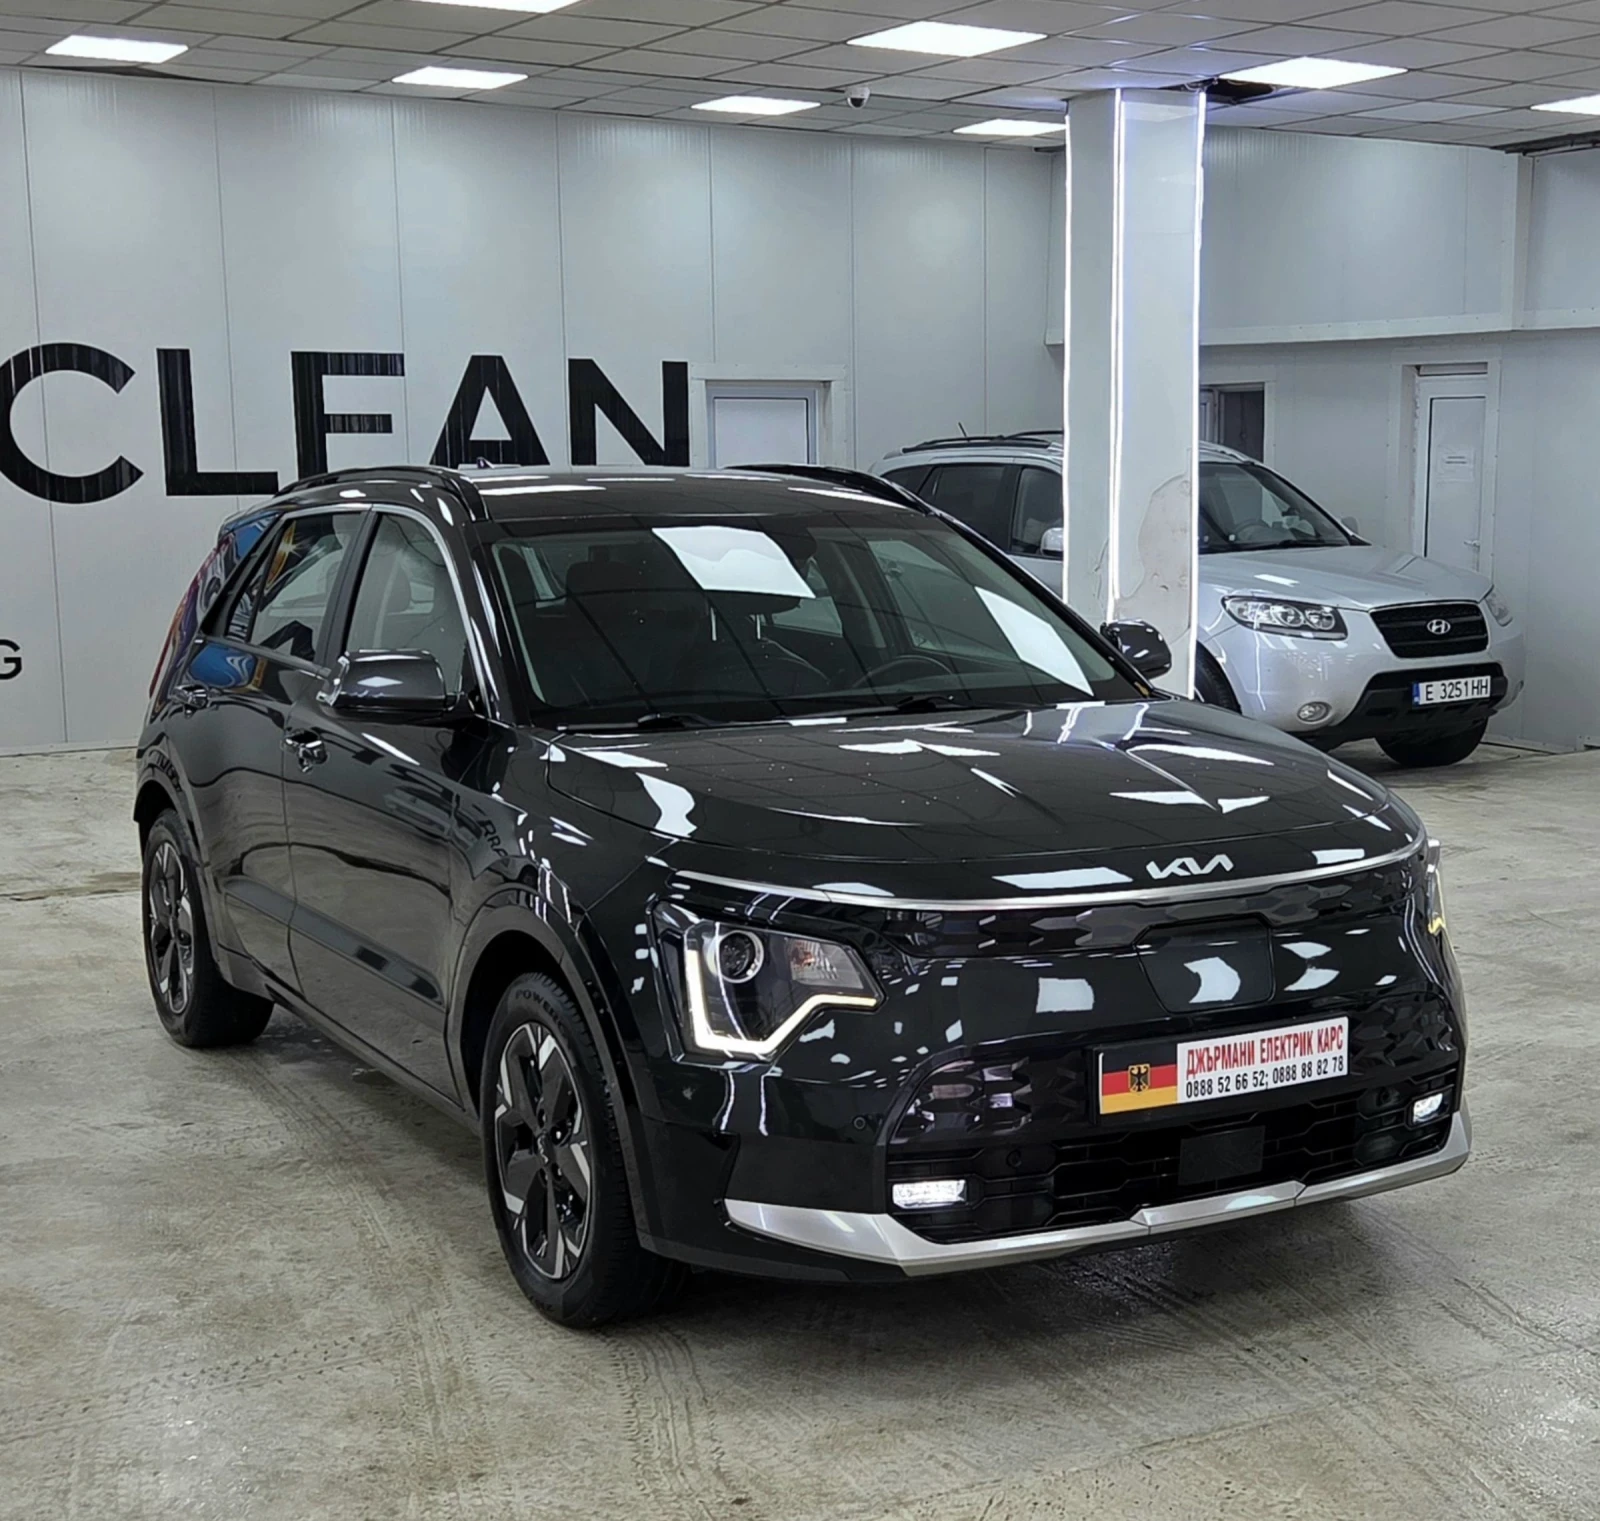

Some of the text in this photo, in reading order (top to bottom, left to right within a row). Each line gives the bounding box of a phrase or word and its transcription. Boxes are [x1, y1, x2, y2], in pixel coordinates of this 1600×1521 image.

[0, 342, 690, 503] CLEAN
[1186, 1024, 1344, 1080] ДЖЪРМАНИ ЕЛЕКТРИК КАРС
[1186, 1054, 1344, 1099] 0888 52 66 52; 0888 88 82 78
